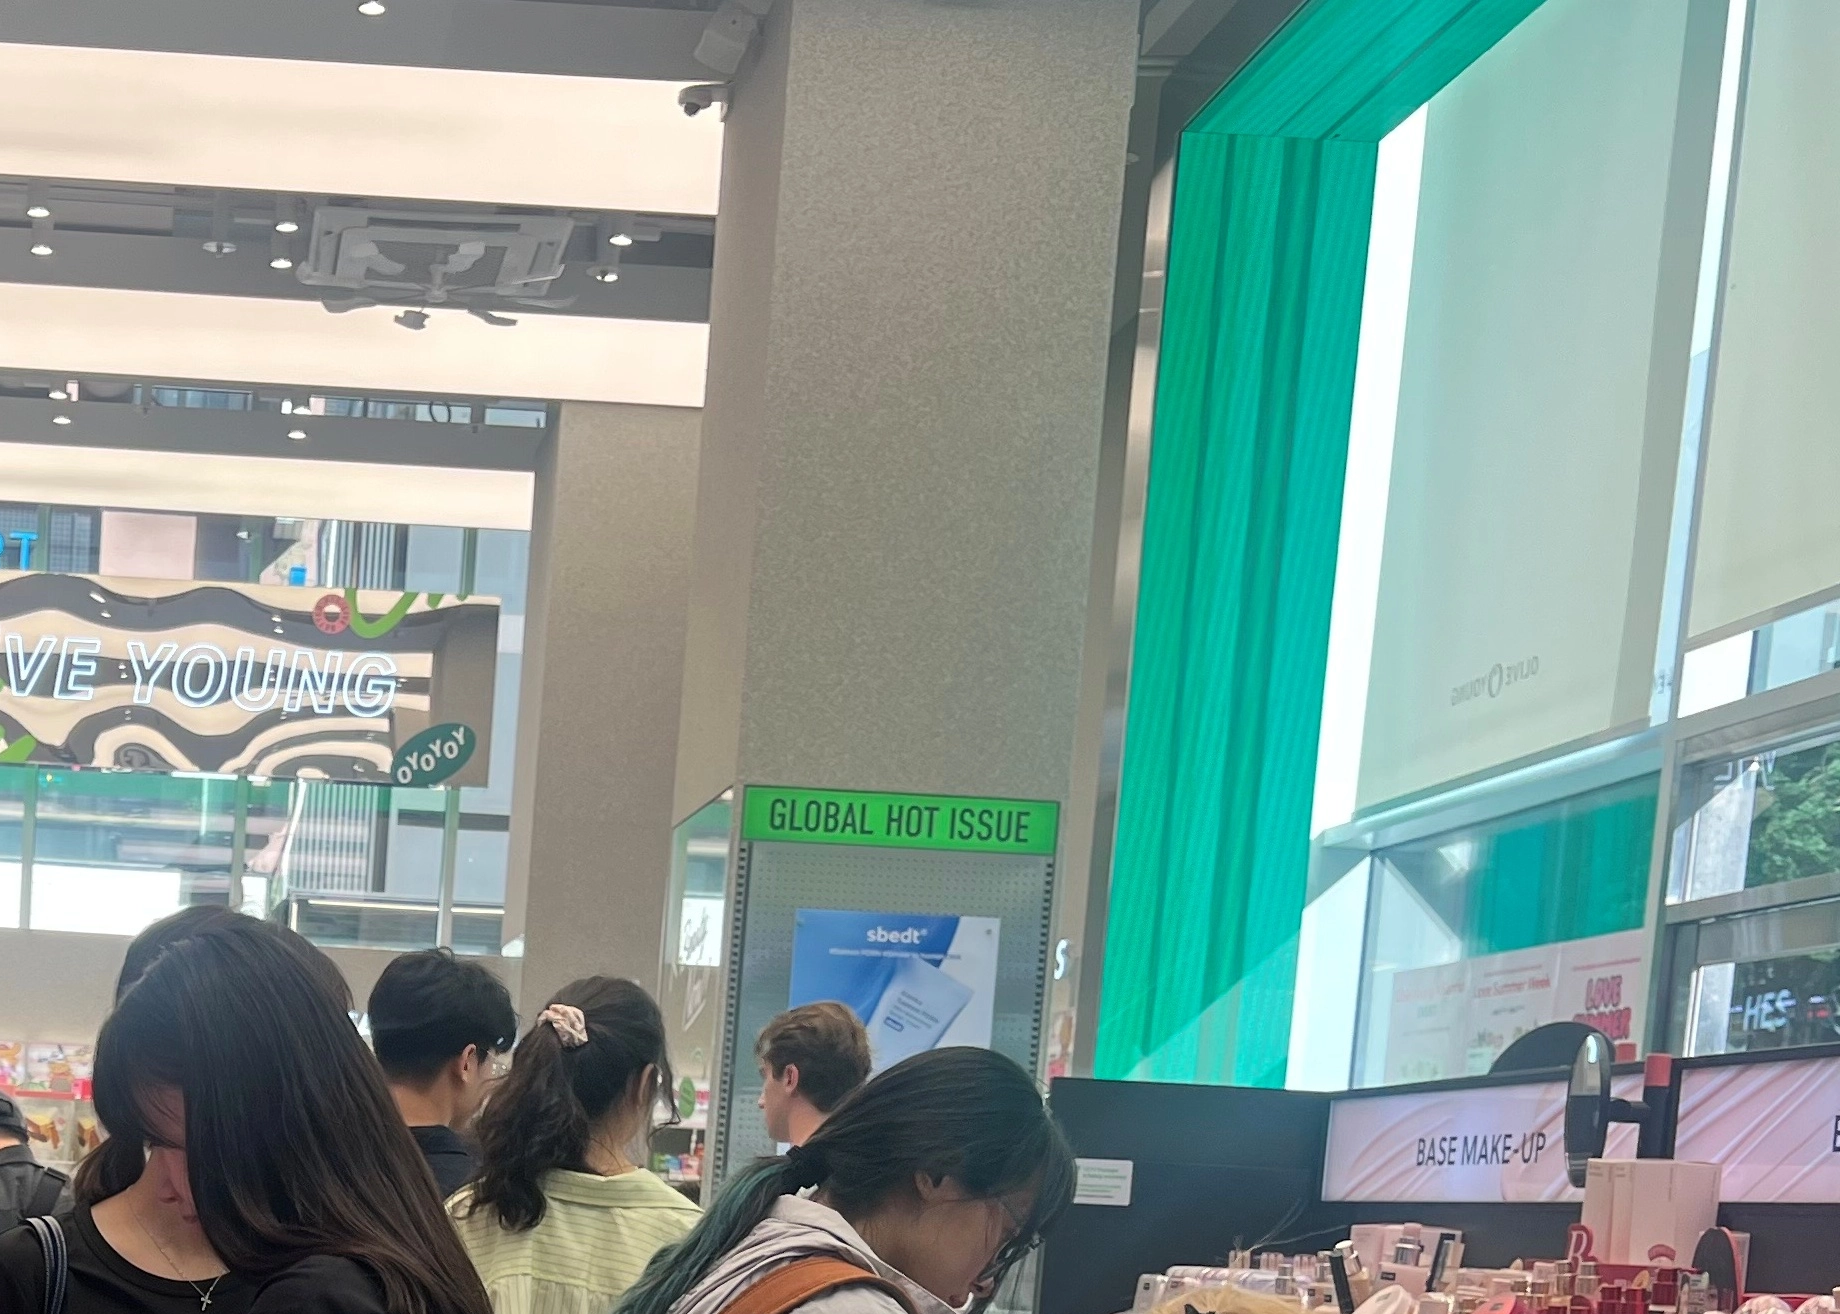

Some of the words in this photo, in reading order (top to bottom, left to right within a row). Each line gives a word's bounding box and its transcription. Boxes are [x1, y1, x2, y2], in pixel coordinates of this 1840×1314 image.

[126, 639, 397, 718] YOUNG
[396, 726, 466, 785] OYOYOY
[769, 798, 874, 836] GLOBAL
[885, 804, 940, 839] HOT
[948, 807, 1031, 844] ISSUE
[1584, 974, 1624, 1011] LOVE
[1416, 1136, 1458, 1166] BASE
[1460, 1131, 1547, 1166] MAKE-UP
